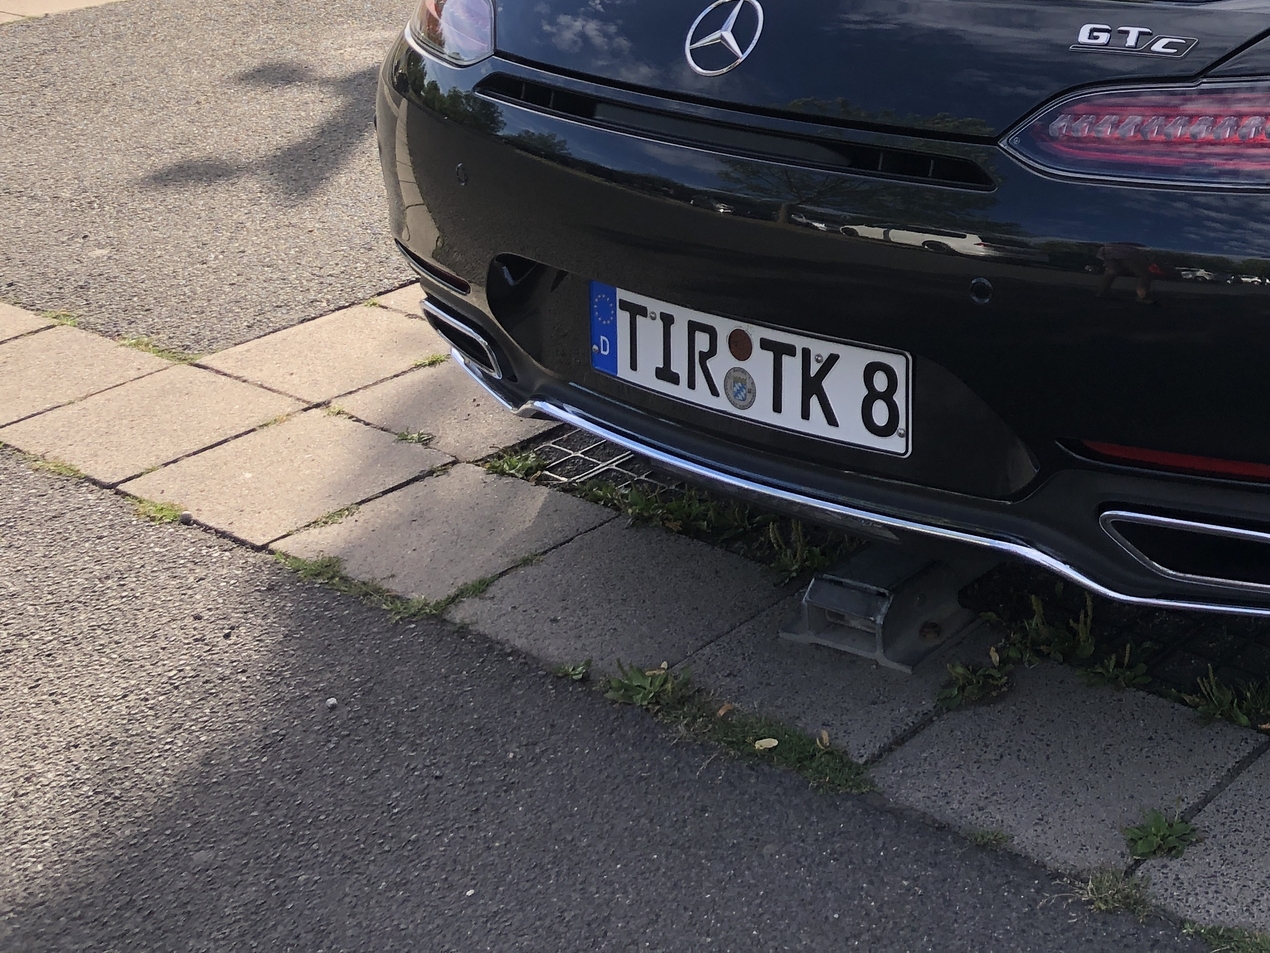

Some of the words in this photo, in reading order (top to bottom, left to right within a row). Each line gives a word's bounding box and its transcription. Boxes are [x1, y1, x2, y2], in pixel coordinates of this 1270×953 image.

[600, 335, 610, 356] D
[618, 298, 720, 397] TIR
[760, 337, 840, 427] TK
[861, 361, 900, 438] 8
